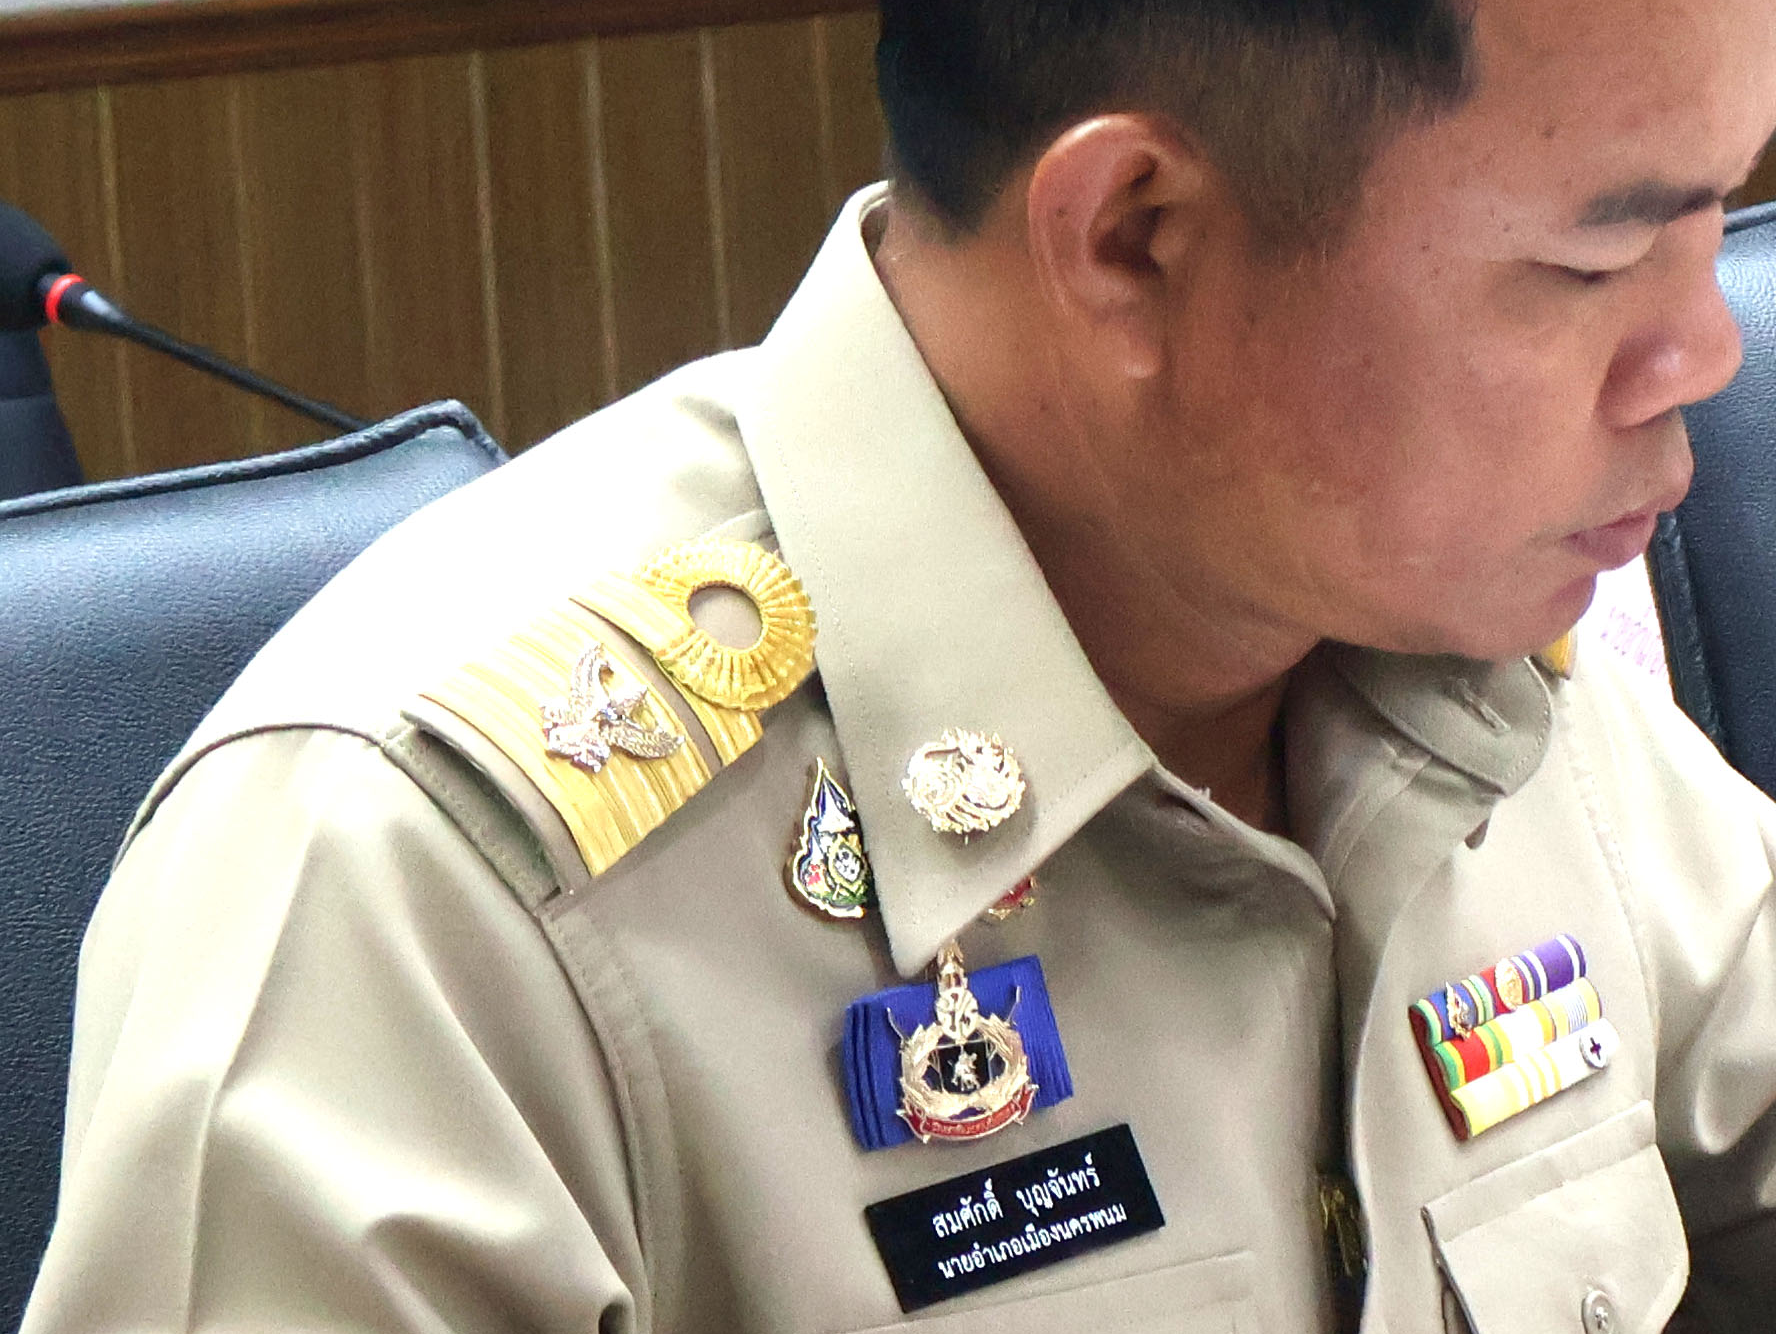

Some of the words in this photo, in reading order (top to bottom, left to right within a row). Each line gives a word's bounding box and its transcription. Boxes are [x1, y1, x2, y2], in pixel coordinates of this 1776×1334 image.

[932, 1178, 1003, 1239] สมศักดิ์
[1016, 1152, 1101, 1217] บุญจันทร์
[937, 1202, 1128, 1280] นายอำเภอเมืองนครพนม
